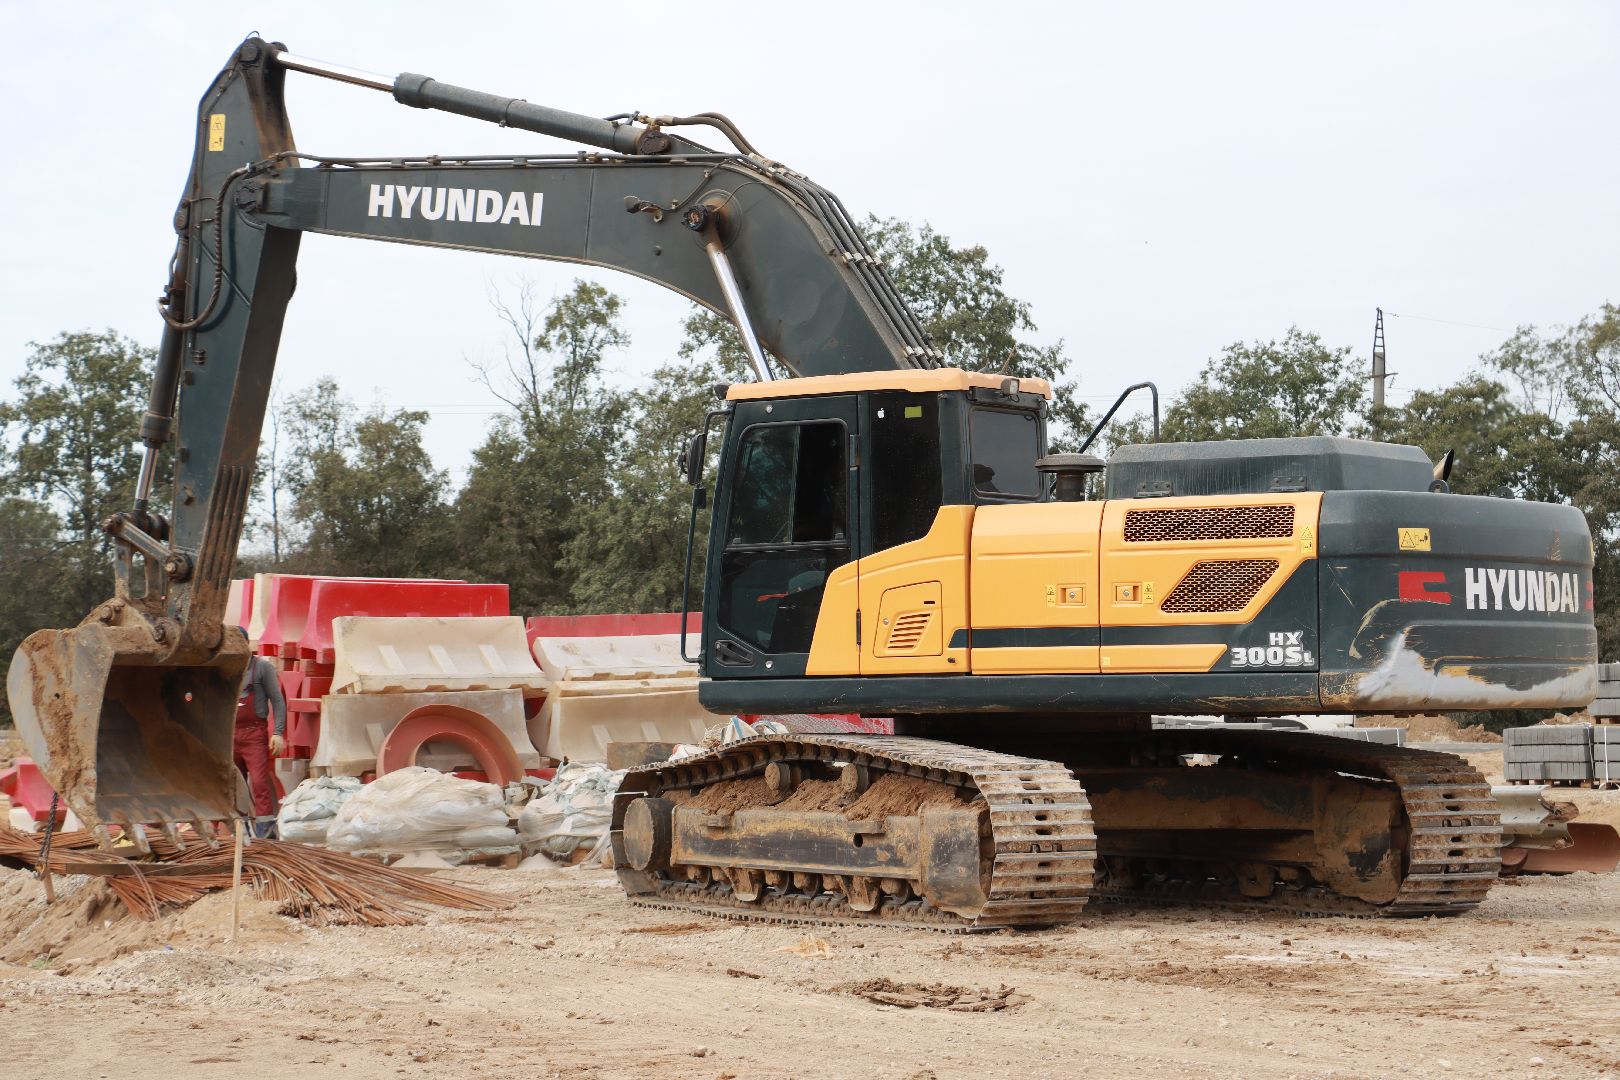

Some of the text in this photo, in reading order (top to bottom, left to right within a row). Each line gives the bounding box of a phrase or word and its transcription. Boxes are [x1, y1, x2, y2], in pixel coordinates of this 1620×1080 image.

[368, 184, 544, 226] HYUNDAI
[1465, 567, 1579, 614] HYUNDAI
[1269, 631, 1303, 646] HX
